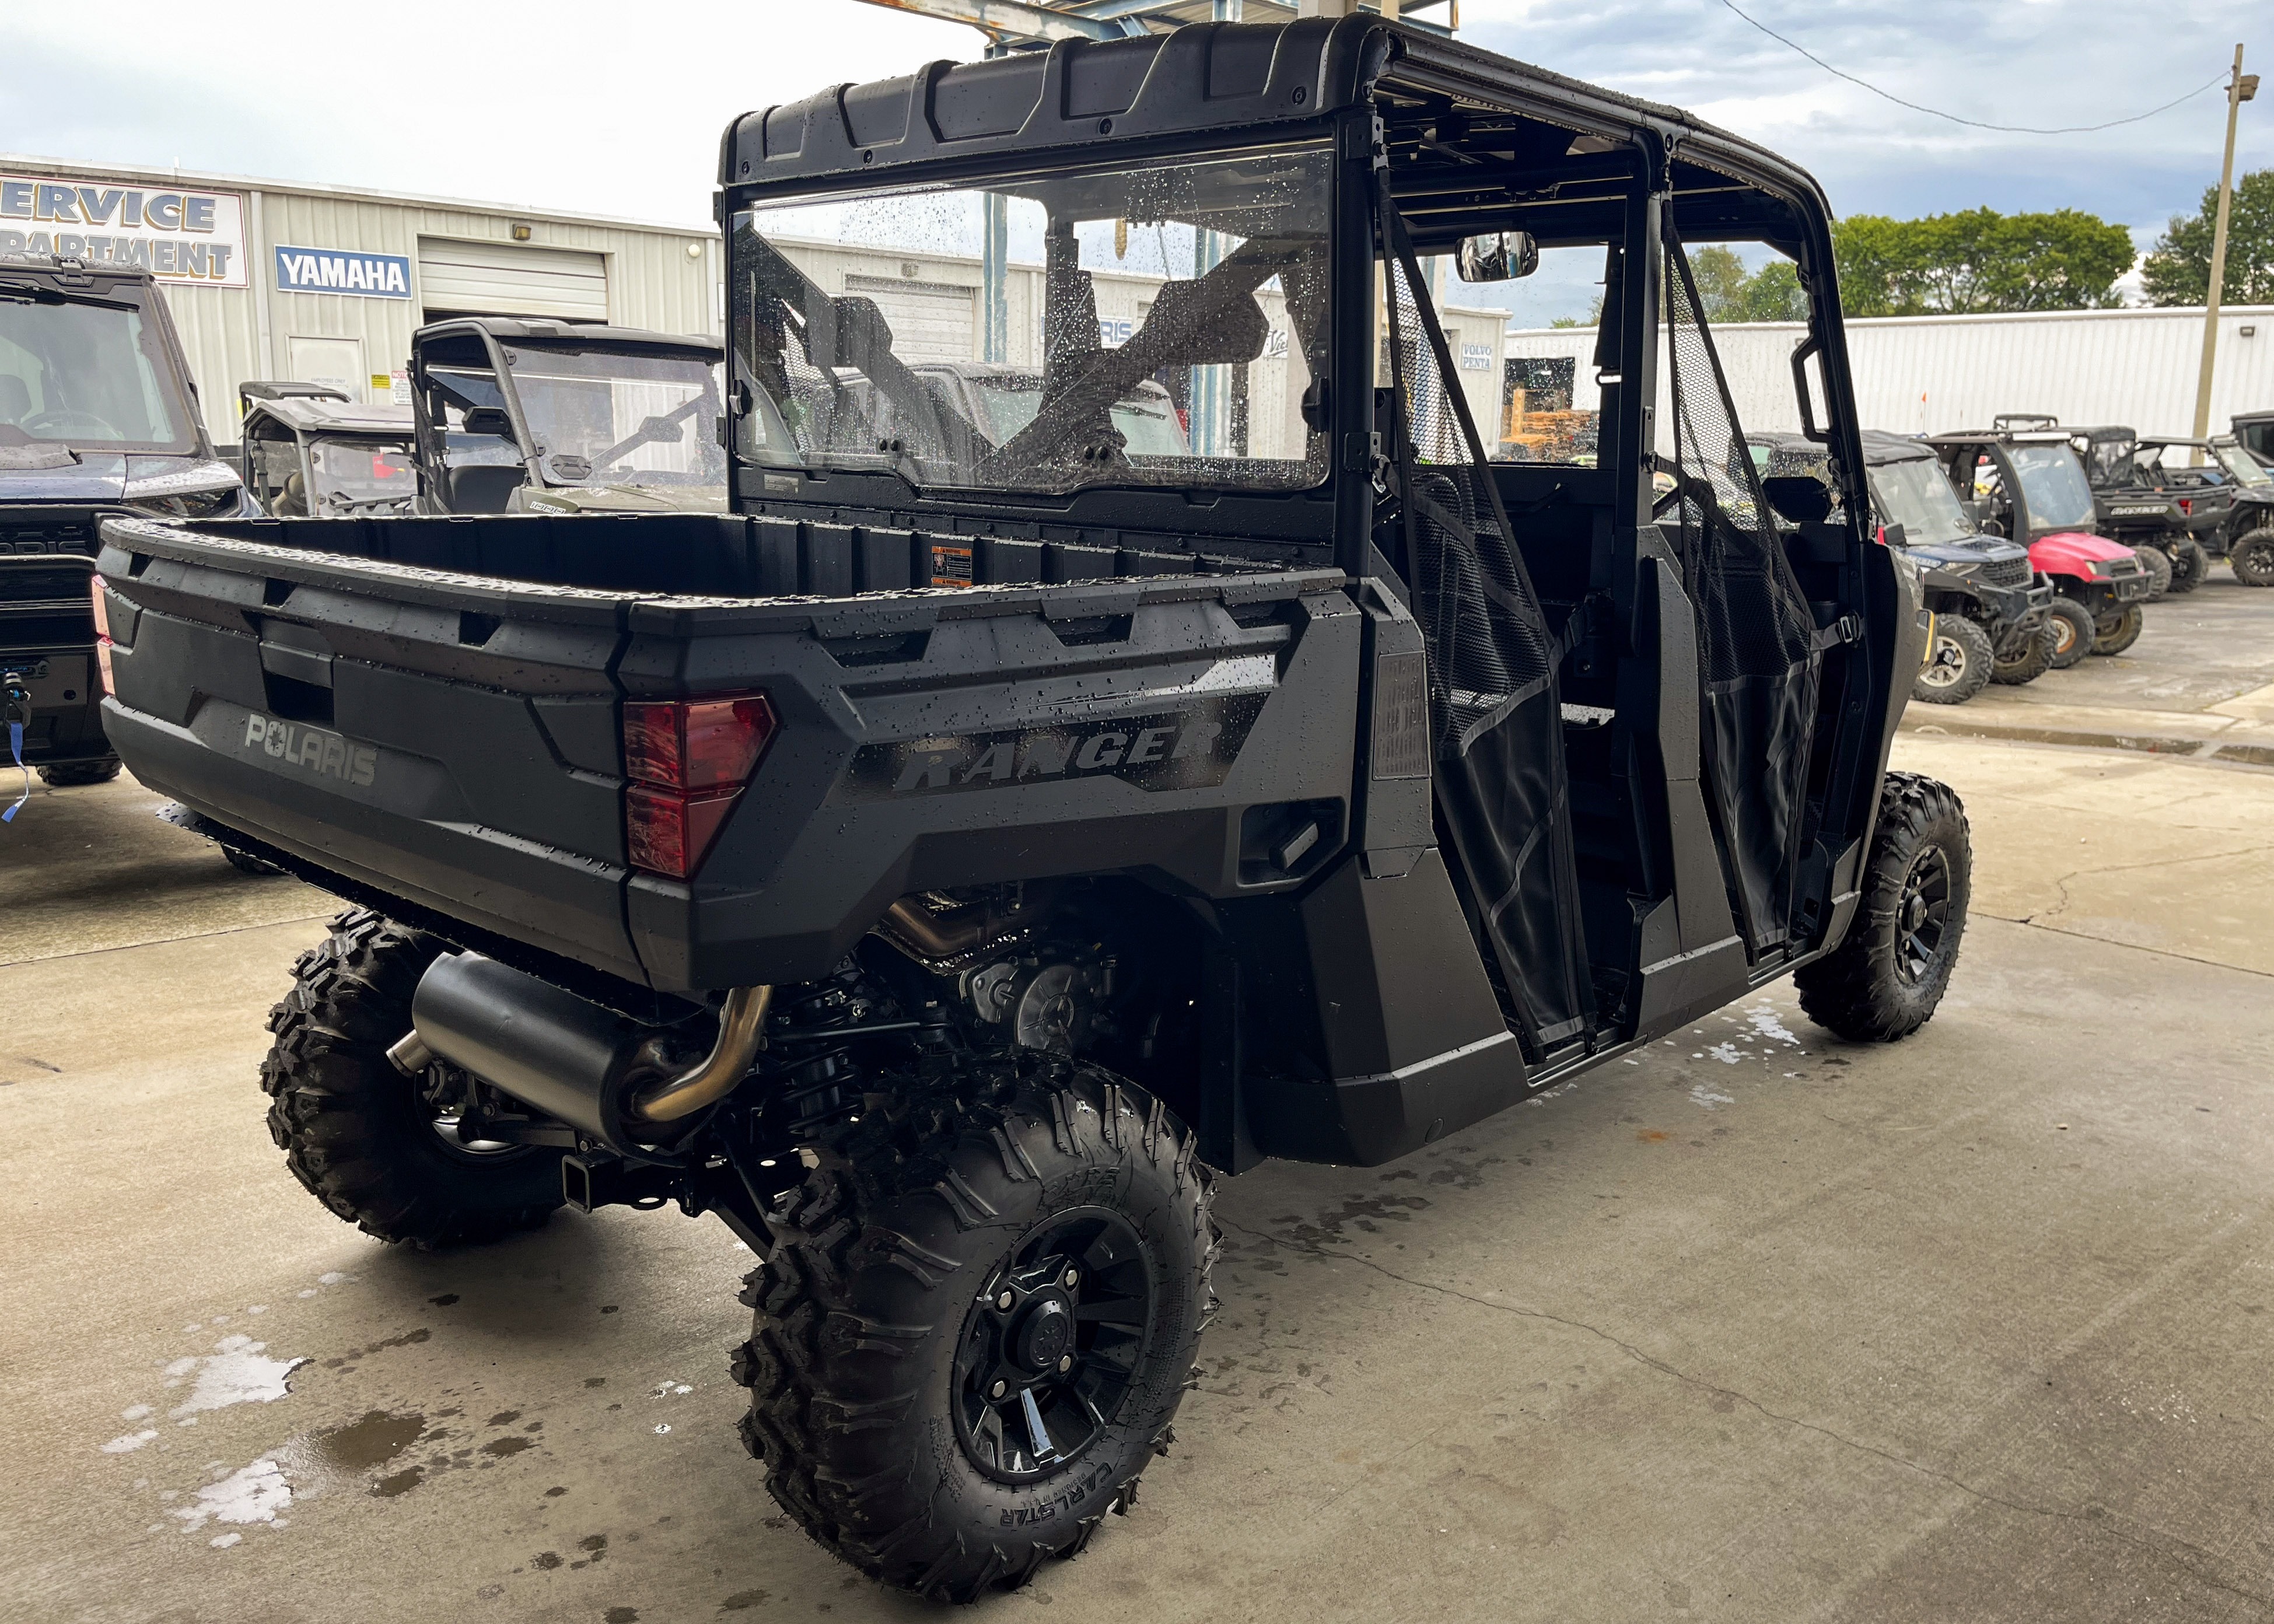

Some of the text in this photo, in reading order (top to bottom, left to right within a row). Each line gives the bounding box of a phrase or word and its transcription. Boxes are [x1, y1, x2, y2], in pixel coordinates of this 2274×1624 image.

[0, 180, 217, 233] ERVICE
[281, 253, 407, 292] YAMAHA
[1463, 356, 1490, 369] PENTA
[1464, 344, 1492, 355] VOLVO
[530, 501, 566, 514] 1000
[245, 713, 377, 786] POLARIS
[892, 722, 1222, 791] RANGER
[1000, 1461, 1112, 1527] CARLSTAR
